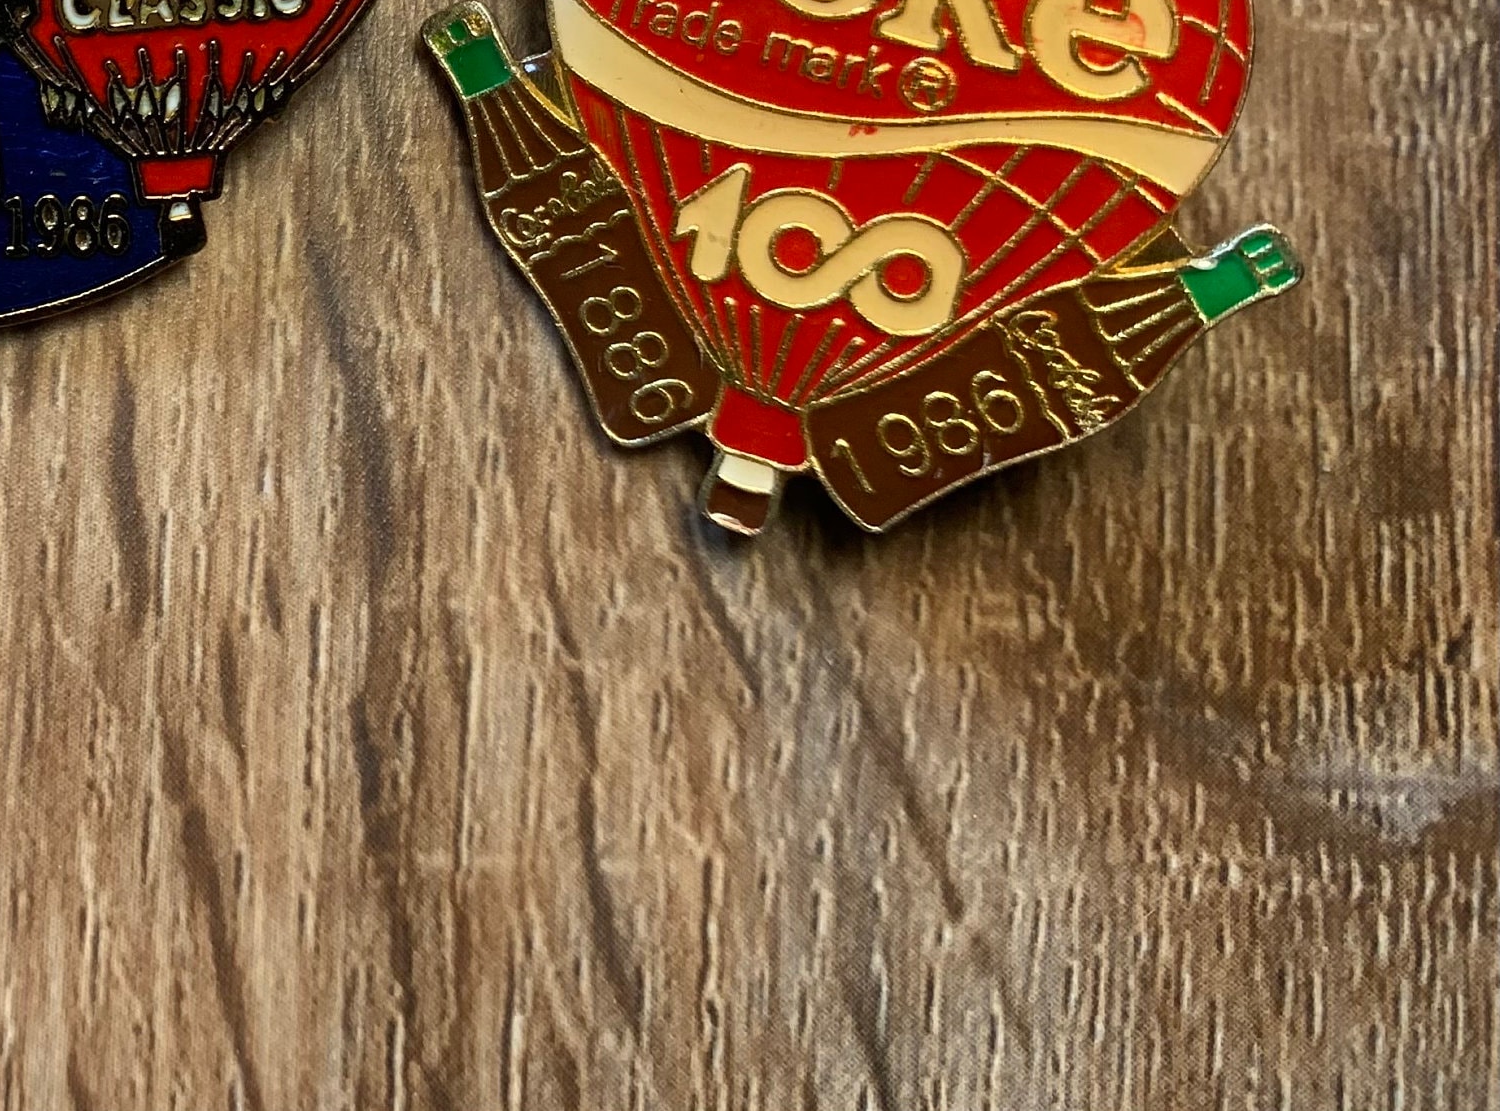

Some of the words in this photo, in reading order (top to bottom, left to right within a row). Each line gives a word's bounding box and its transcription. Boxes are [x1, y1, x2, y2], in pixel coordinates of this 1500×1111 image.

[760, 31, 894, 99] mark
[2, 192, 132, 261] 1986
[558, 241, 694, 424] 1886
[828, 369, 1027, 495] 1986
